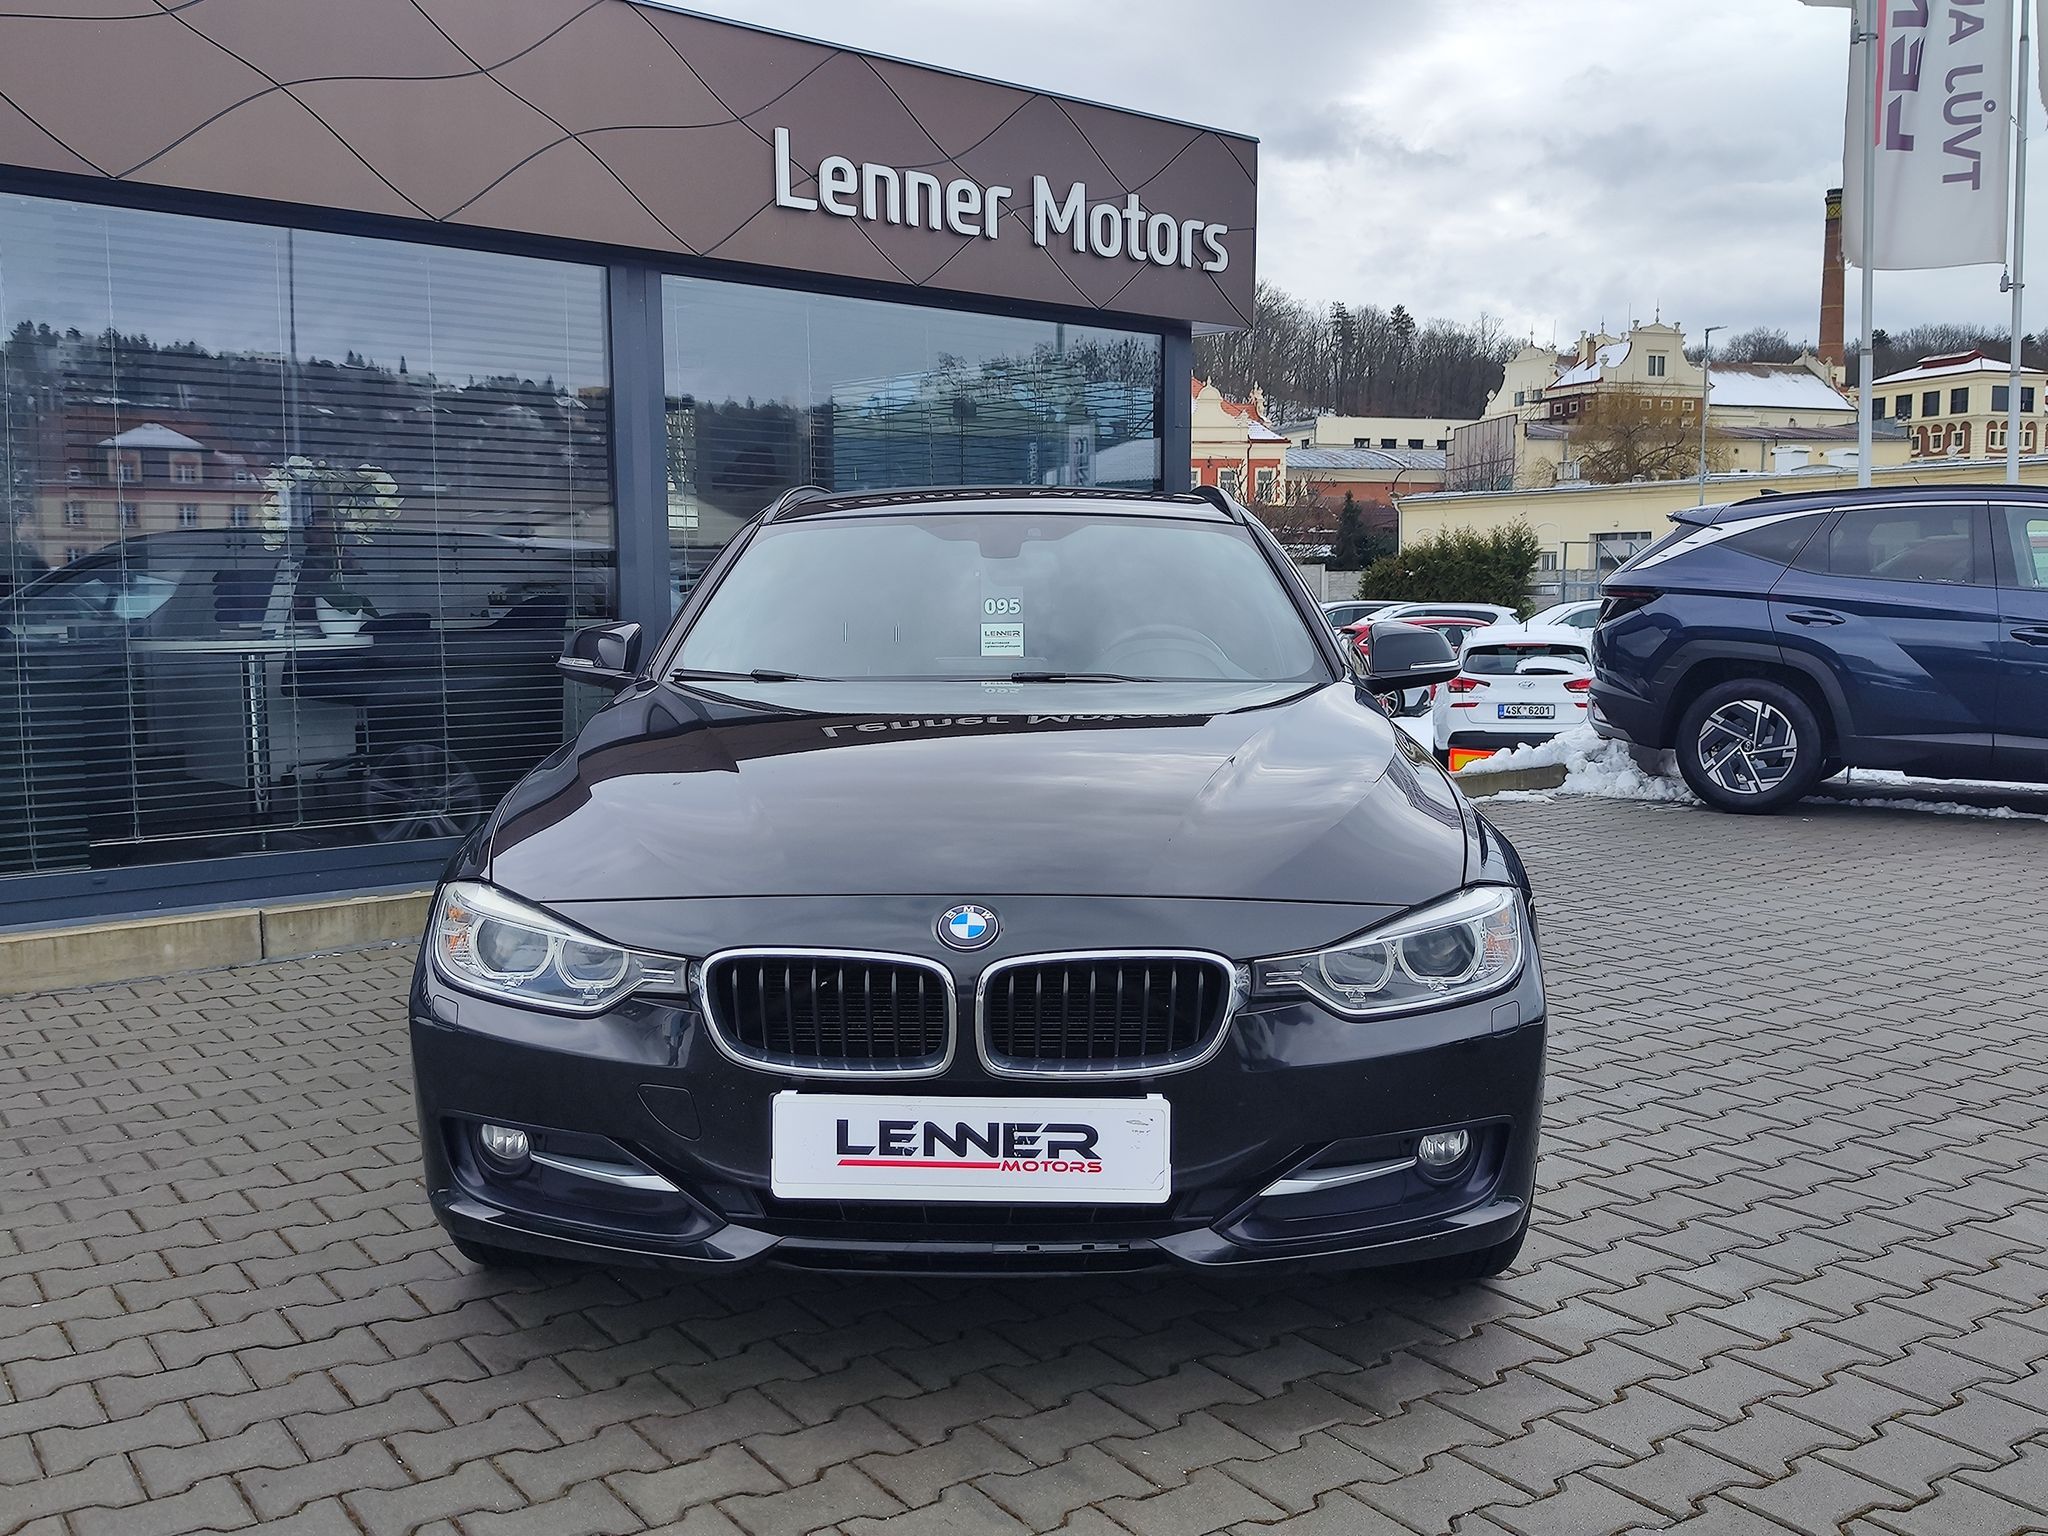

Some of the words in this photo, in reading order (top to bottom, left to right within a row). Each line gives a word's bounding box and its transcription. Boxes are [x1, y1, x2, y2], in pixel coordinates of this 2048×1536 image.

[774, 127, 1012, 240] Lenner
[1032, 174, 1229, 273] Motors
[984, 598, 1021, 615] 095
[1505, 706, 1522, 715] 4SK
[1528, 706, 1550, 715] 6201
[945, 905, 993, 920] BMW
[836, 1118, 1102, 1160] LENNER
[1000, 1159, 1103, 1174] MOTORS
